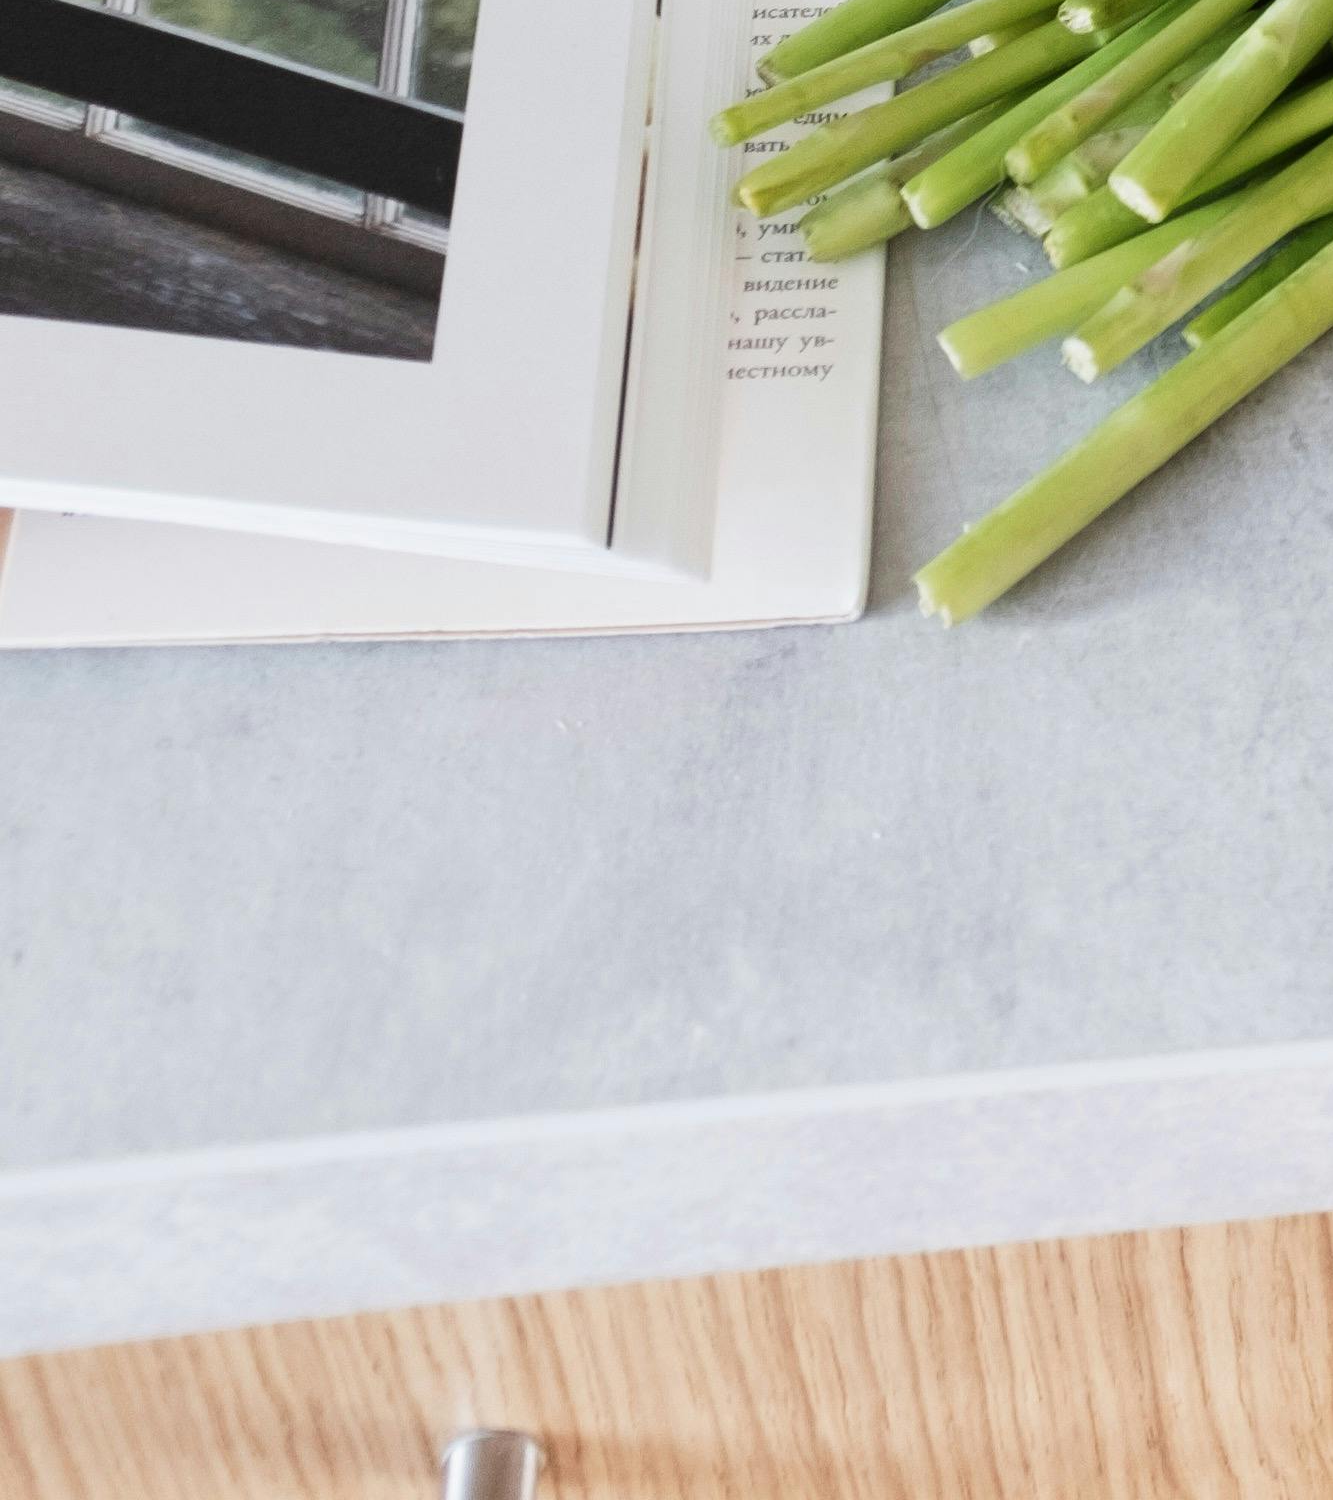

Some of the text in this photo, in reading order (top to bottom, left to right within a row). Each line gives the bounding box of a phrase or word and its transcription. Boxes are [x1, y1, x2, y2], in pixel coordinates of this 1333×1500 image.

[761, 251, 812, 264] стат
[743, 277, 839, 293] видение
[754, 306, 837, 326] рассла-
[727, 336, 788, 354] нашу
